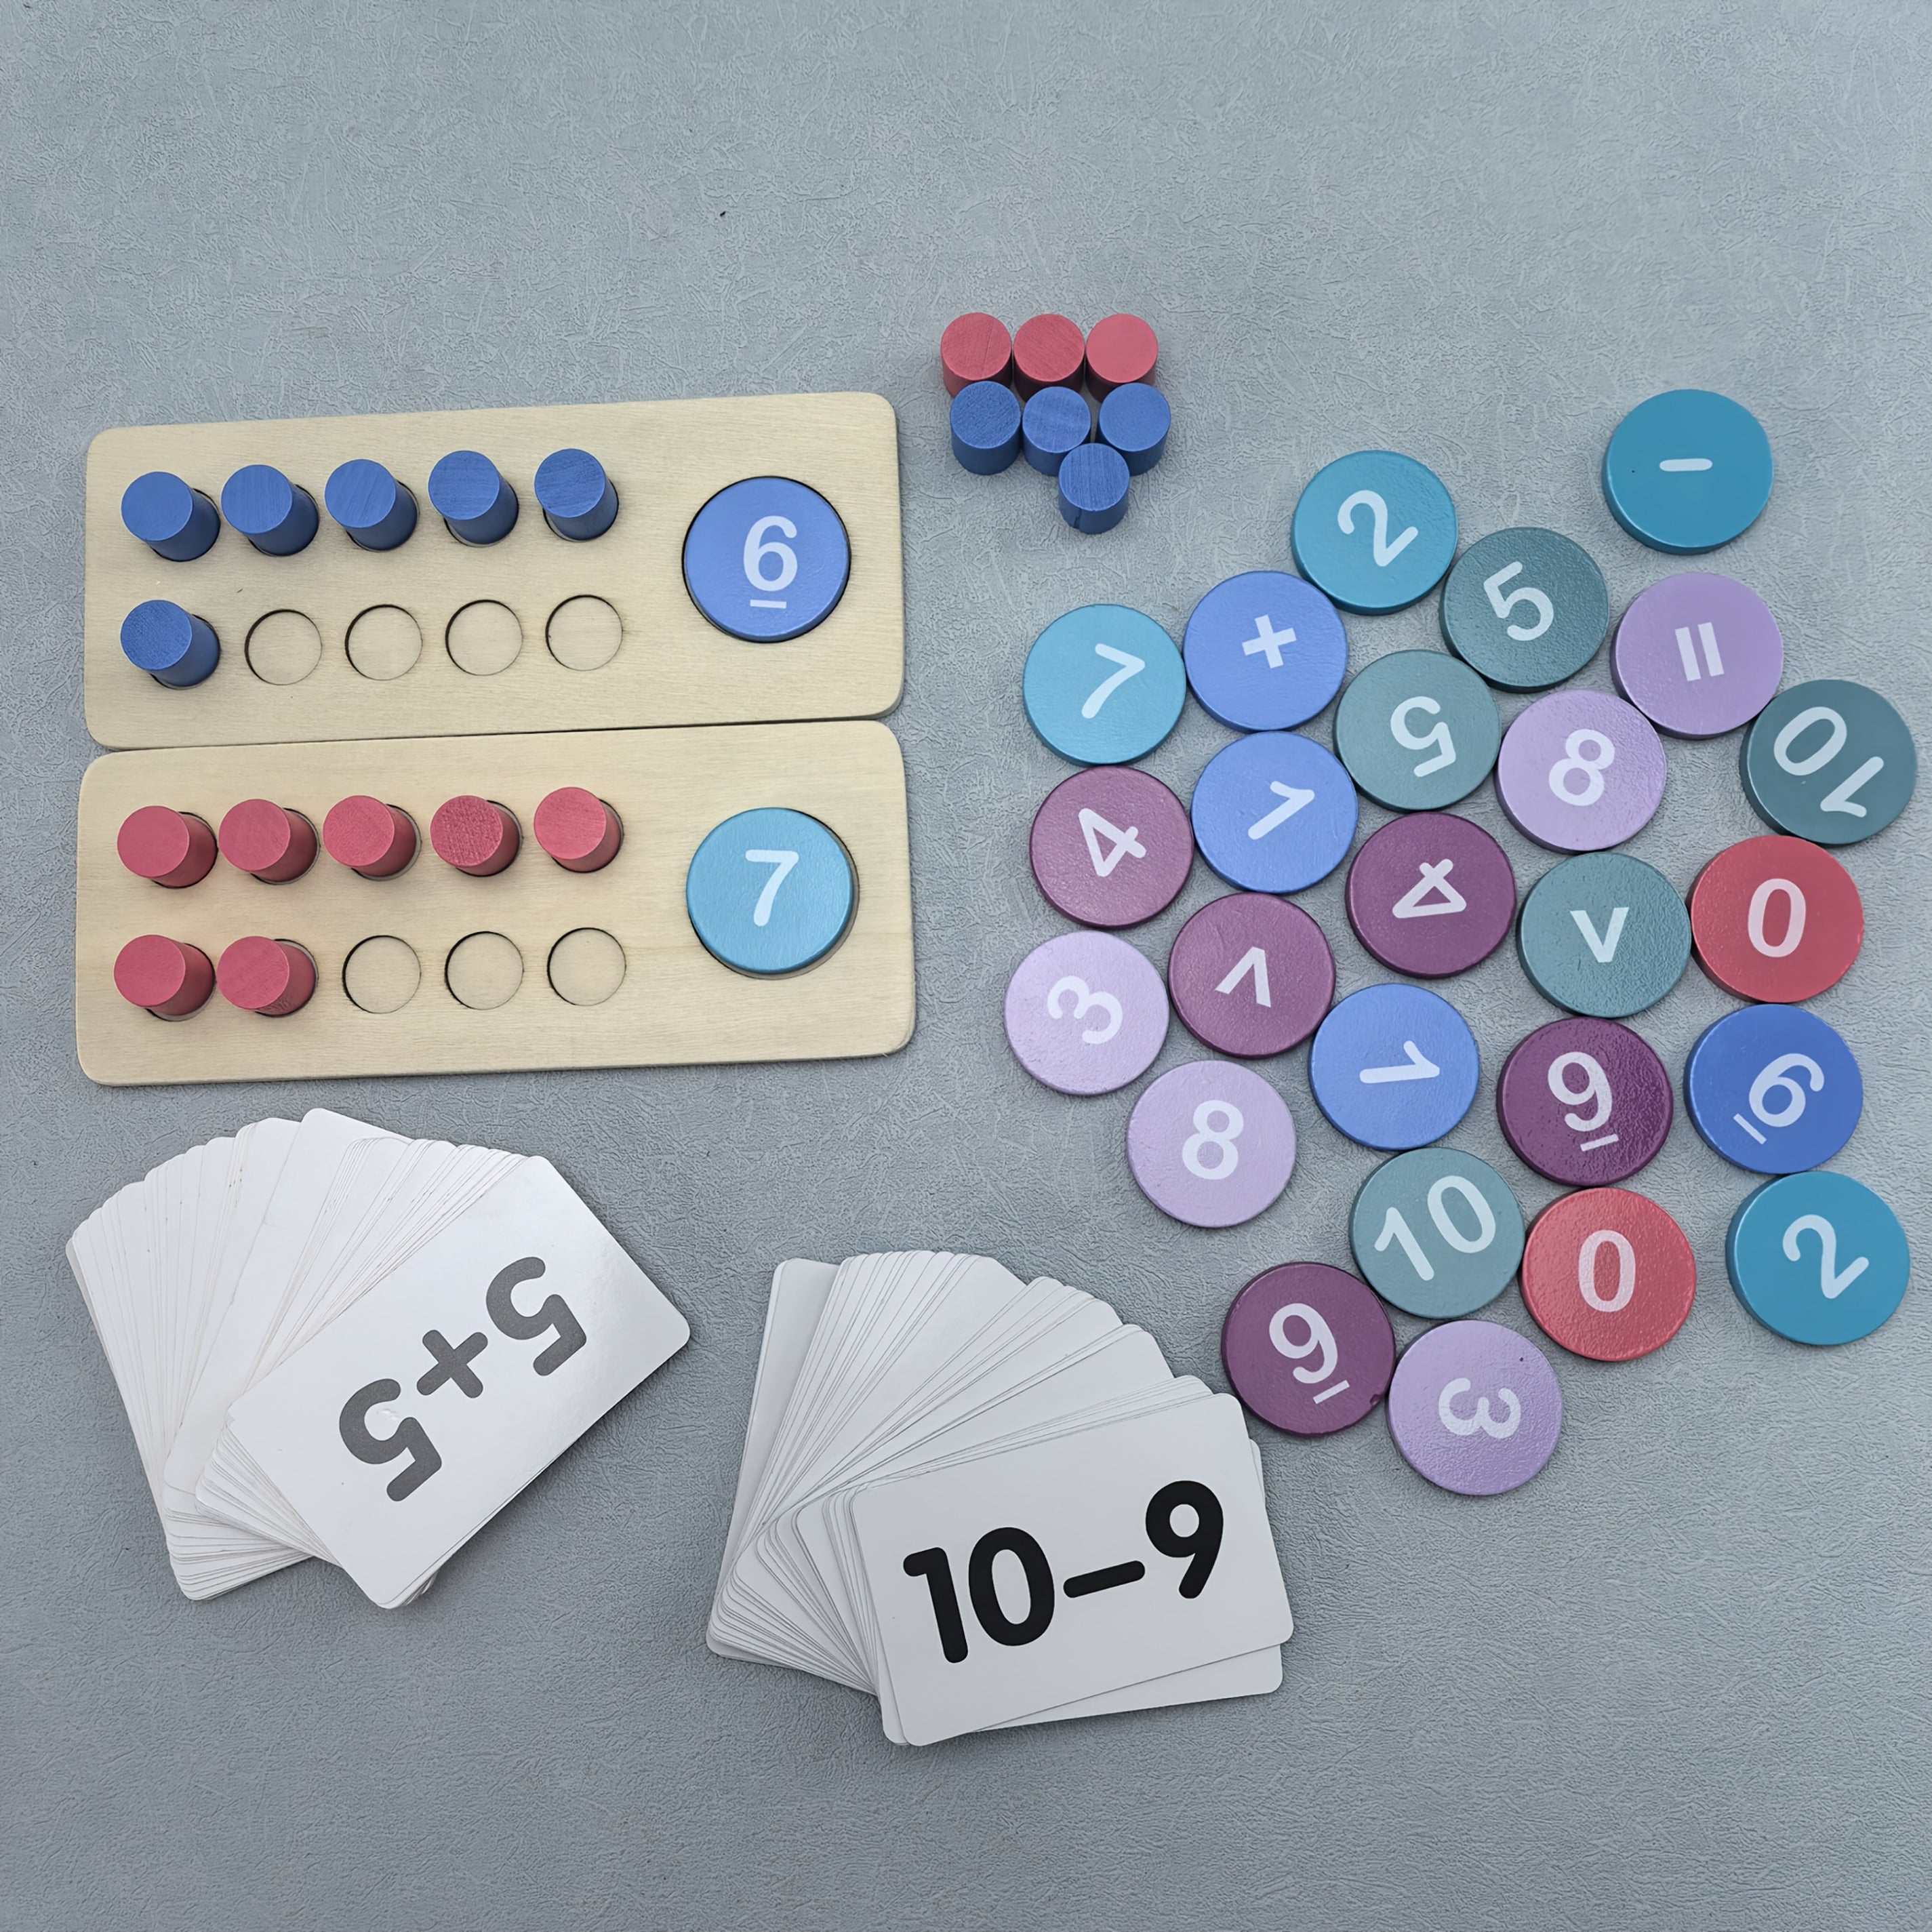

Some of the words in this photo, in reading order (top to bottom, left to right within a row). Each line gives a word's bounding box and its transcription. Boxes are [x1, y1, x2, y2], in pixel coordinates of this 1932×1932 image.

[744, 516, 797, 609] 6
[1337, 490, 1418, 567] 2
[1483, 561, 1554, 641] 5
[1082, 644, 1145, 719] 7
[1390, 696, 1455, 777] 5
[1549, 729, 1615, 806] 8
[1774, 707, 1884, 817] 10
[1079, 808, 1146, 877] 4
[1248, 781, 1314, 839] 1
[746, 849, 799, 926] 7
[1392, 859, 1466, 918] 4
[1748, 879, 1806, 957] 0
[1047, 975, 1123, 1044] 3
[1360, 1041, 1440, 1083] 1
[1548, 1051, 1619, 1151] 9
[1733, 1053, 1824, 1144] 6
[1182, 1100, 1244, 1180] 8
[1375, 1175, 1495, 1281] 10
[1783, 1215, 1869, 1299] 2
[1578, 1230, 1635, 1312] 0
[1269, 1304, 1350, 1404] 9
[1438, 1377, 1521, 1439] 3
